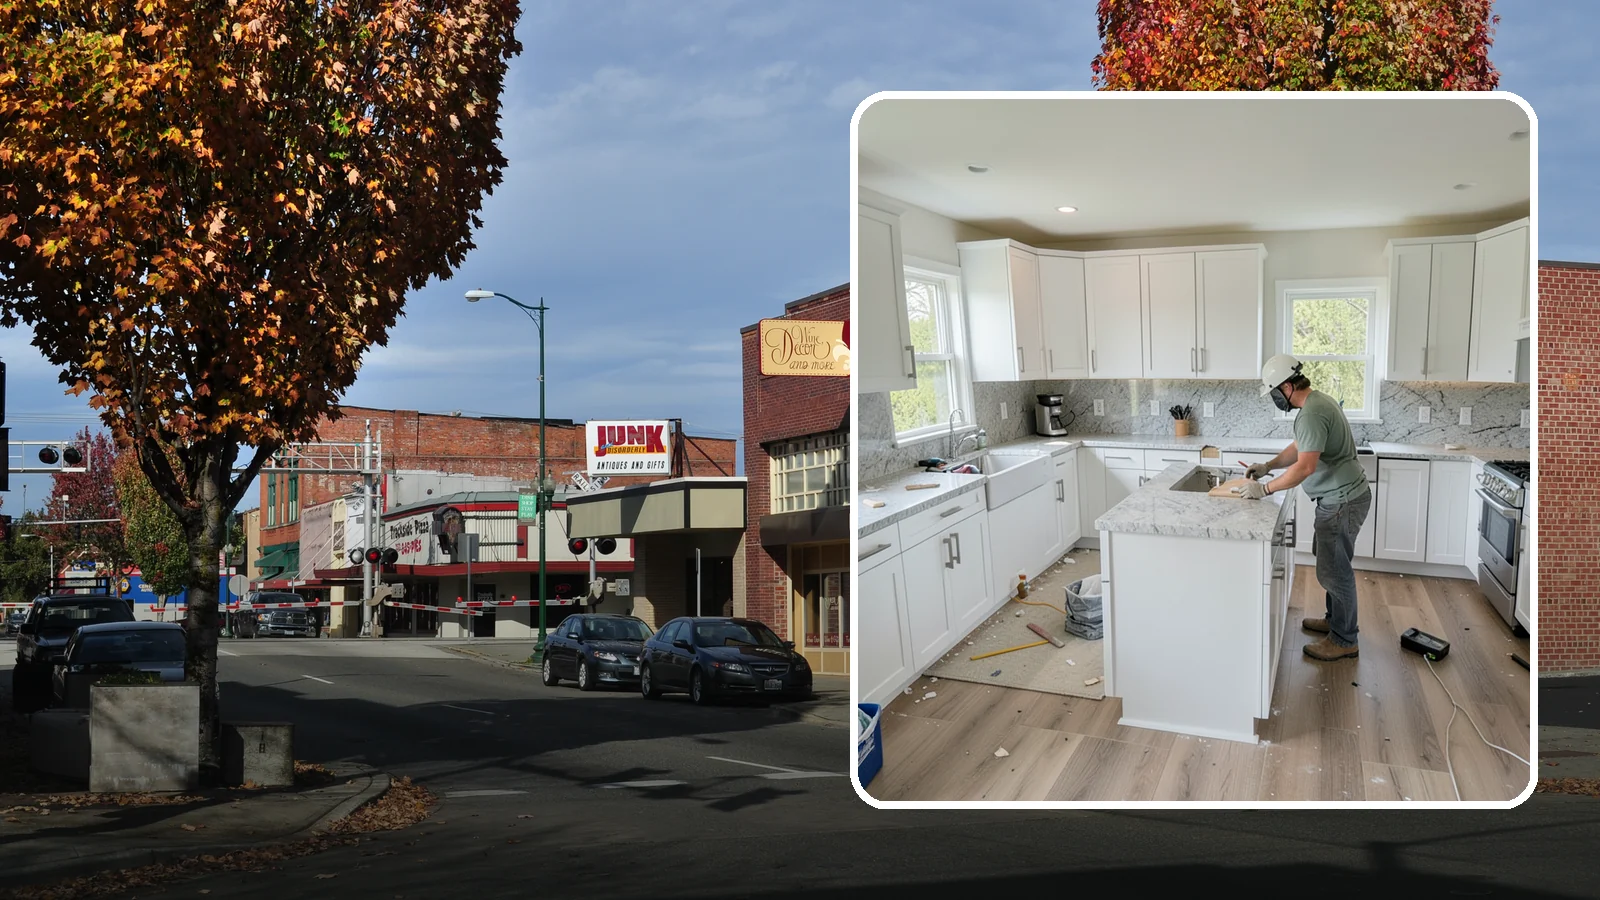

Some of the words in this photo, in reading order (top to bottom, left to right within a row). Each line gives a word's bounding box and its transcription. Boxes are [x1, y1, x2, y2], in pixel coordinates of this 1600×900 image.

[596, 425, 664, 457] JUNK
[607, 446, 646, 454] DISORDERLY
[597, 461, 628, 470] ANTIQUES
[631, 461, 644, 470] AND
[647, 460, 666, 470] GIFTS
[390, 521, 413, 539] Trackside
[414, 519, 429, 535] Pizza
